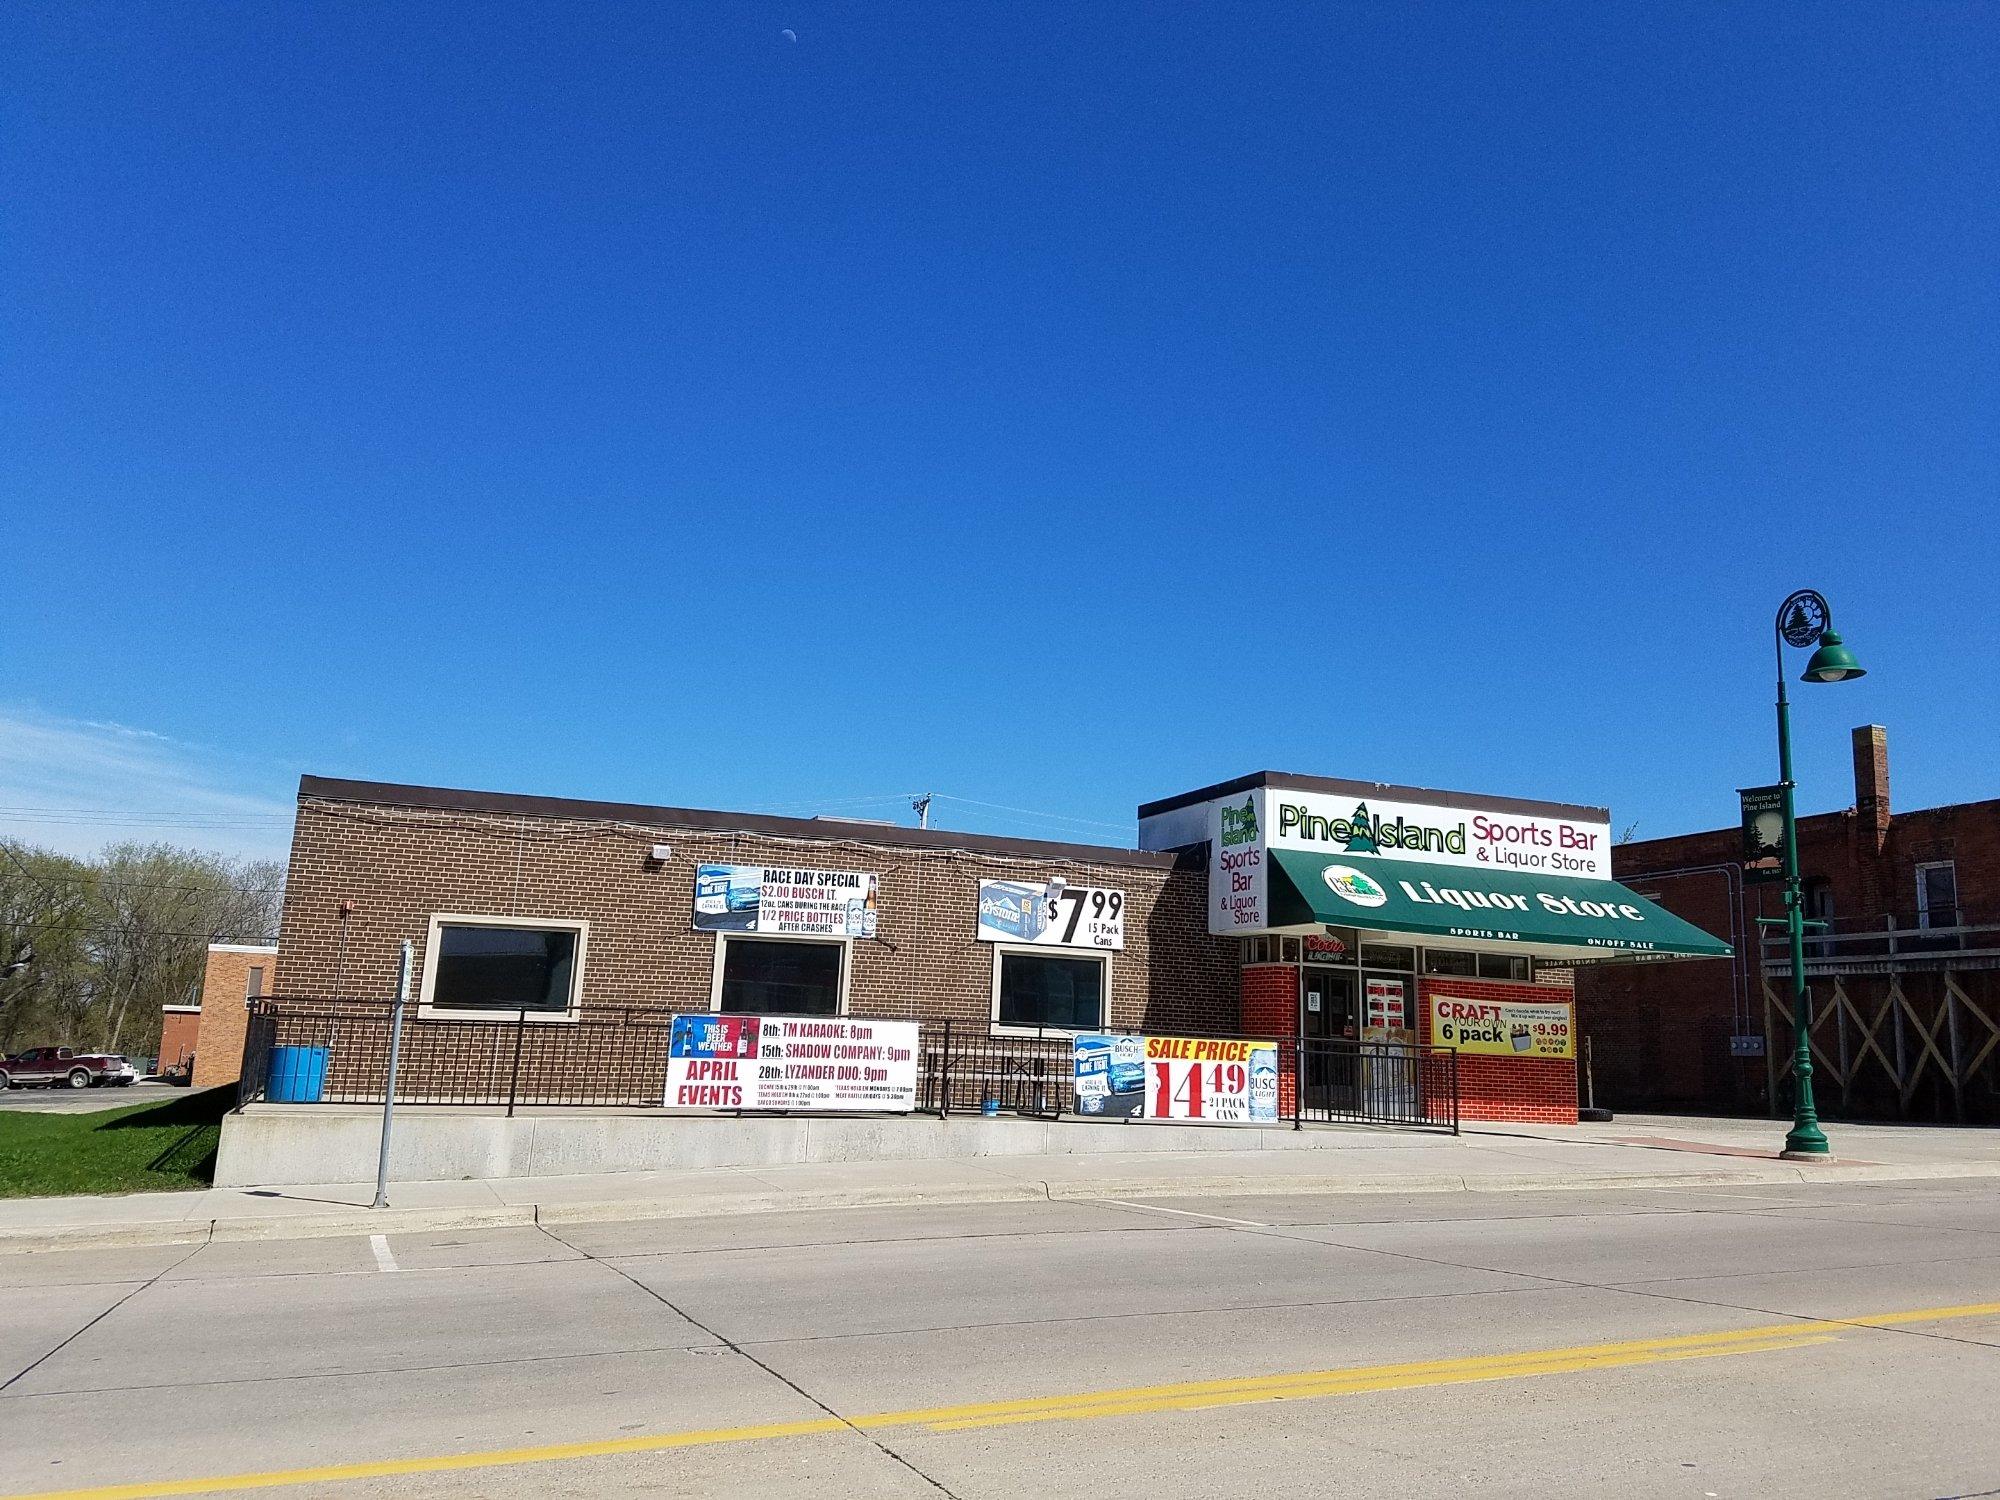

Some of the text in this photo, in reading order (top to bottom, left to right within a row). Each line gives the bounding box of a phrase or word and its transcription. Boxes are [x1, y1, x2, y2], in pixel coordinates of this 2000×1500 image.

[1742, 794, 1772, 802] Welcome
[1743, 801, 1781, 812] Pine Island
[1221, 806, 1247, 829] Pine
[1279, 803, 1466, 855] Pine Island
[1472, 815, 1598, 851] Sports Bar
[1221, 827, 1257, 848] Island
[1220, 847, 1260, 870] Sports
[1476, 846, 1597, 873] & Liquor Store
[763, 870, 860, 888] RACE DAY SPECIAL
[1232, 872, 1253, 893] Bar
[761, 886, 838, 900] $2.00 BUSCH LT.
[777, 901, 794, 909] CANS
[794, 902, 818, 910] DURING
[818, 902, 830, 910] THE
[830, 903, 846, 912] RACE
[1220, 894, 1256, 912] & Liquor
[1398, 880, 1645, 921] Liquor Store
[762, 910, 776, 921] 1/2
[778, 911, 804, 922] PRICE
[806, 912, 844, 924] BOTTLES
[1234, 908, 1260, 925] Store
[746, 920, 756, 930] 4
[778, 922, 833, 934] AFTER CRASHES
[1088, 923, 1119, 935] 15 Pack
[1094, 935, 1112, 946] Cans
[1450, 928, 1520, 940] SPORTS BAR
[1588, 938, 1654, 950] ON/OFF SALE
[1437, 1002, 1502, 1020] CRAFT
[704, 1024, 728, 1034] THIS IS
[1453, 1017, 1507, 1028] YOUR OWN
[1532, 1022, 1568, 1036] $9.99
[706, 1033, 725, 1042] BEER
[762, 1023, 872, 1040] 8th: TM KARAOKE: 8pm
[1442, 1023, 1504, 1045] 6 pack
[698, 1042, 732, 1052] WEATHER
[762, 1046, 910, 1062] 15th: SHADOW COMPANY: 9pm
[1114, 1045, 1139, 1054] BUSCH
[1147, 1038, 1249, 1062] SALE PRICE
[686, 1060, 738, 1081] APRIL
[759, 1065, 888, 1082] 28th: LYZANDER DUO: 9pm
[678, 1084, 742, 1106] EVENTS
[1130, 1104, 1142, 1116] 4
[1220, 1098, 1246, 1109] PACK
[1216, 1110, 1239, 1121] CANS
